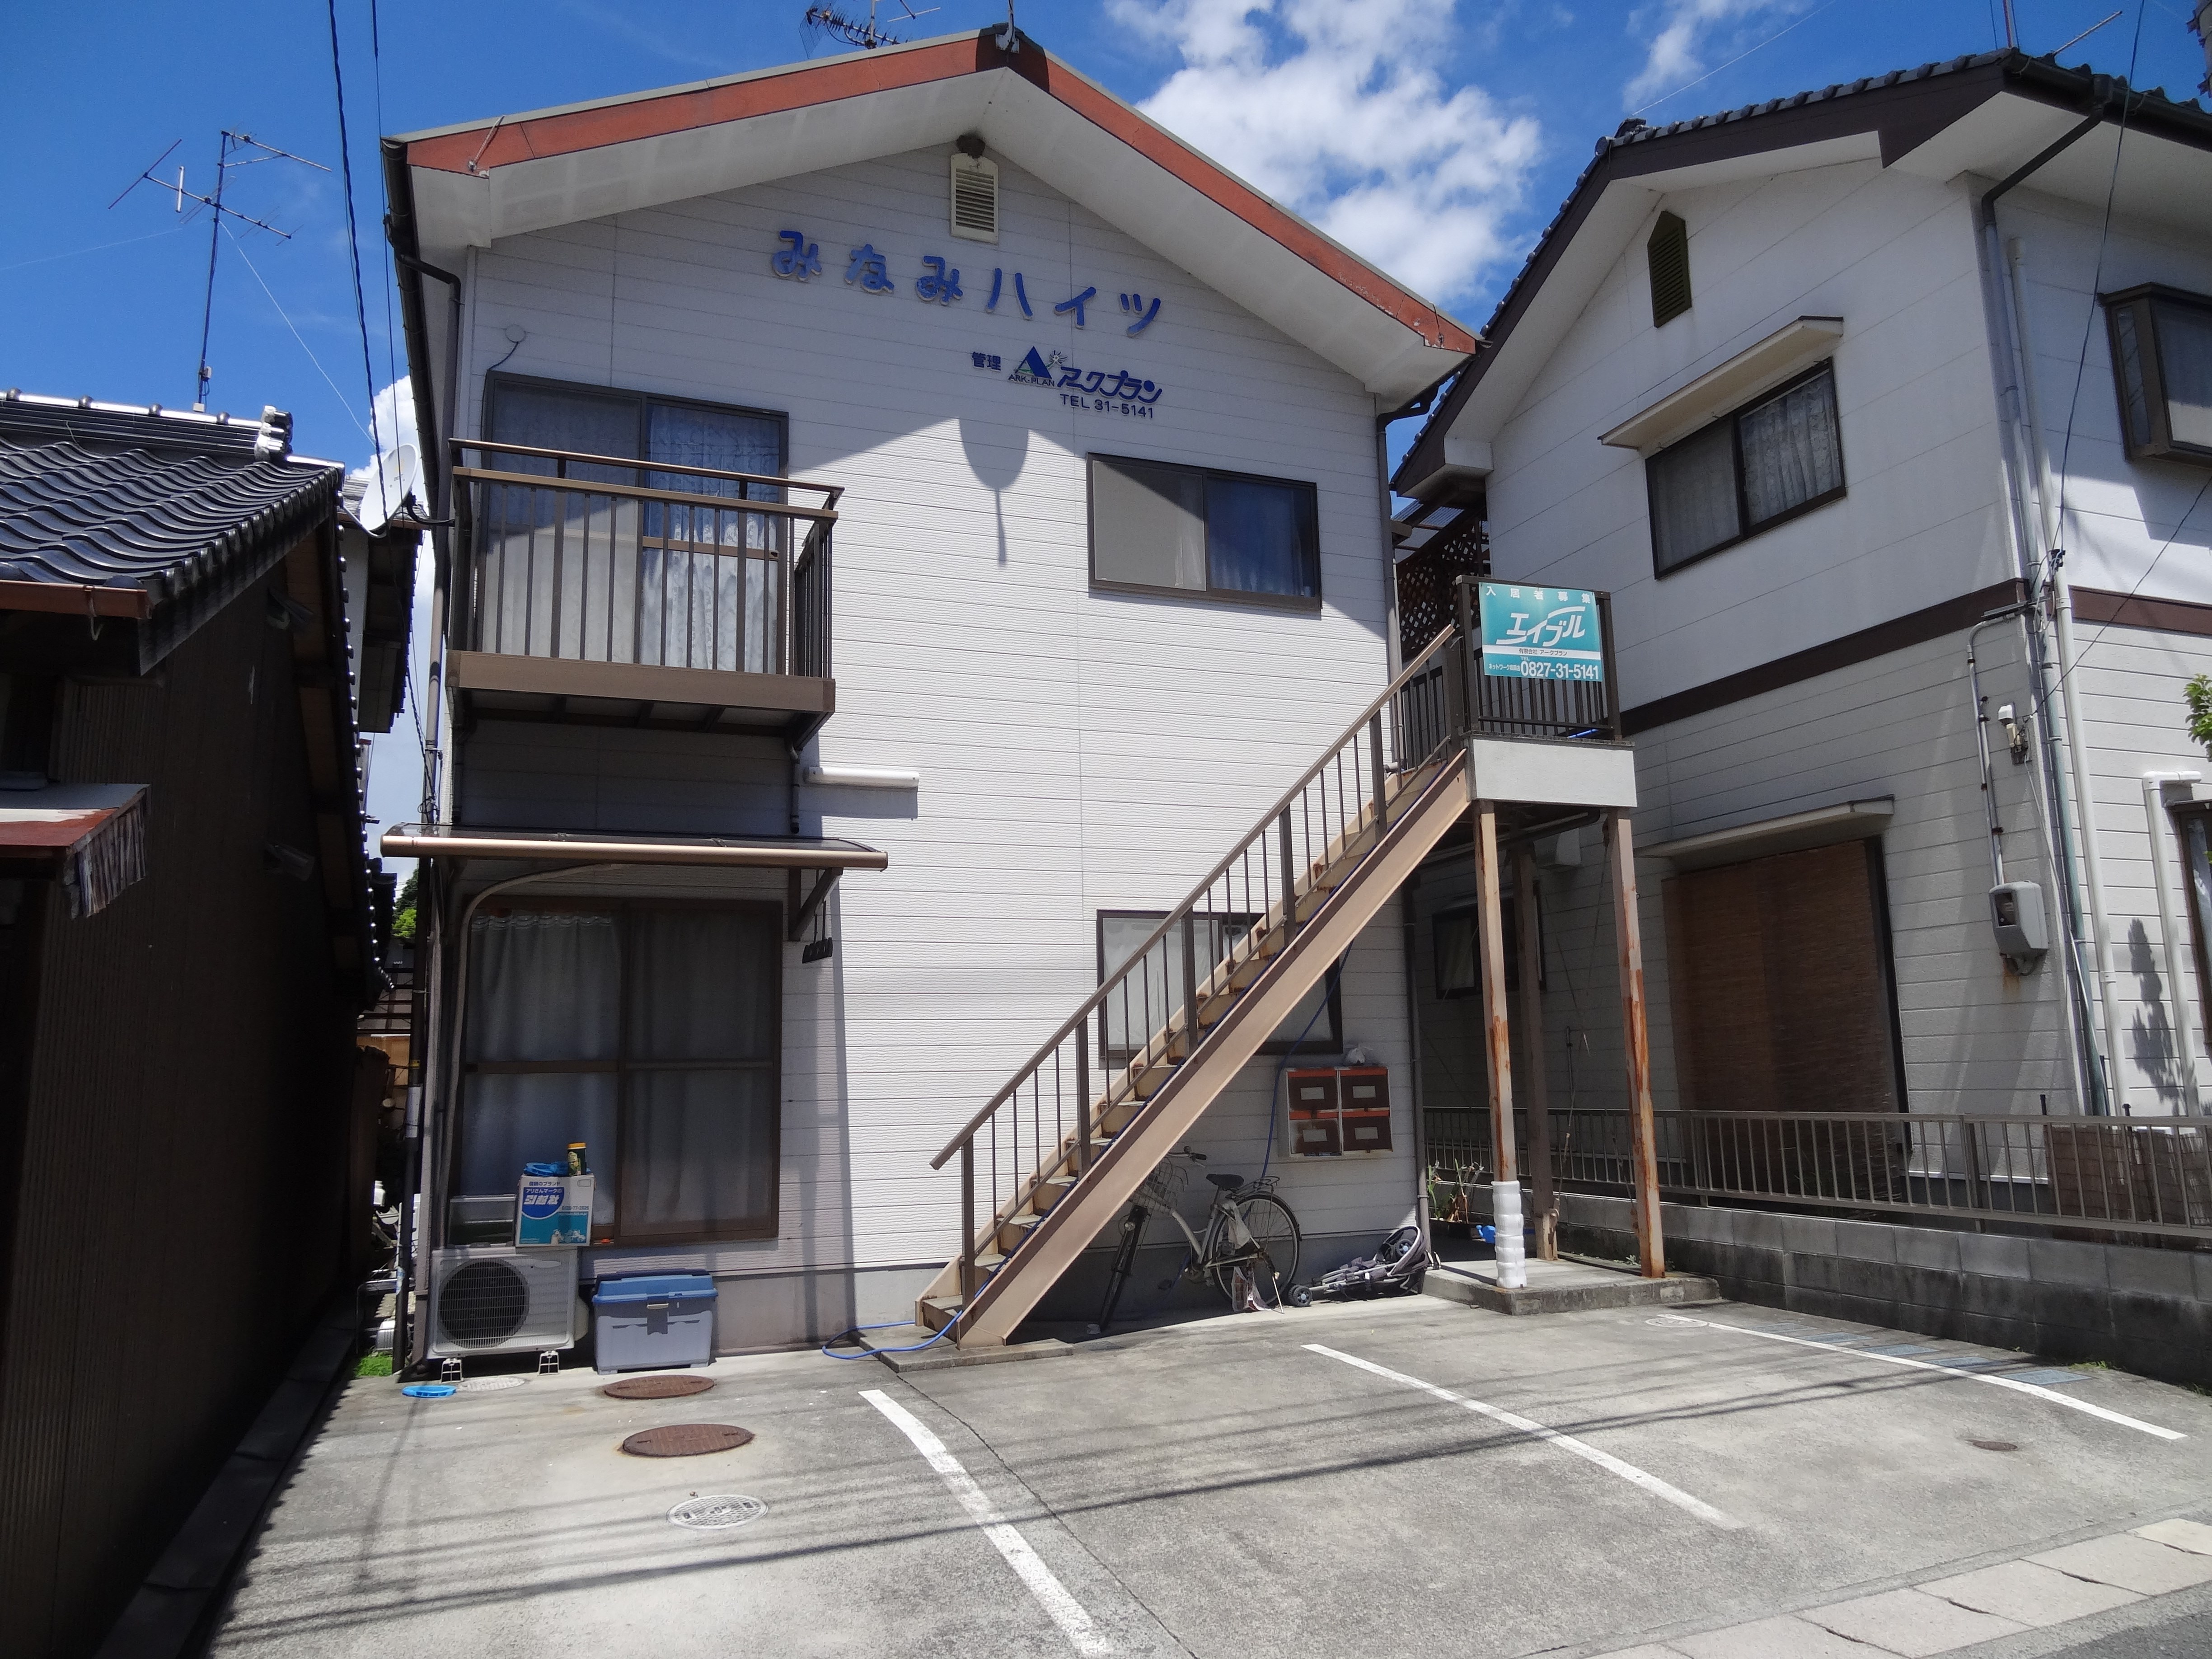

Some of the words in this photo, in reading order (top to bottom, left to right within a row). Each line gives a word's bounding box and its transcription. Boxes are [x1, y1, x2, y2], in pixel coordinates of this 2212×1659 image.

[772, 230, 1162, 338] みなみハイツ
[972, 351, 1002, 371] 管理
[1008, 374, 1055, 387] ARK-PLAN
[1059, 393, 1090, 409] TEL
[1094, 398, 1154, 419] 31-5141
[1486, 586, 1591, 604] 入居者募集
[1496, 606, 1586, 647] エイブル
[1520, 661, 1598, 680] 0827-31-5141
